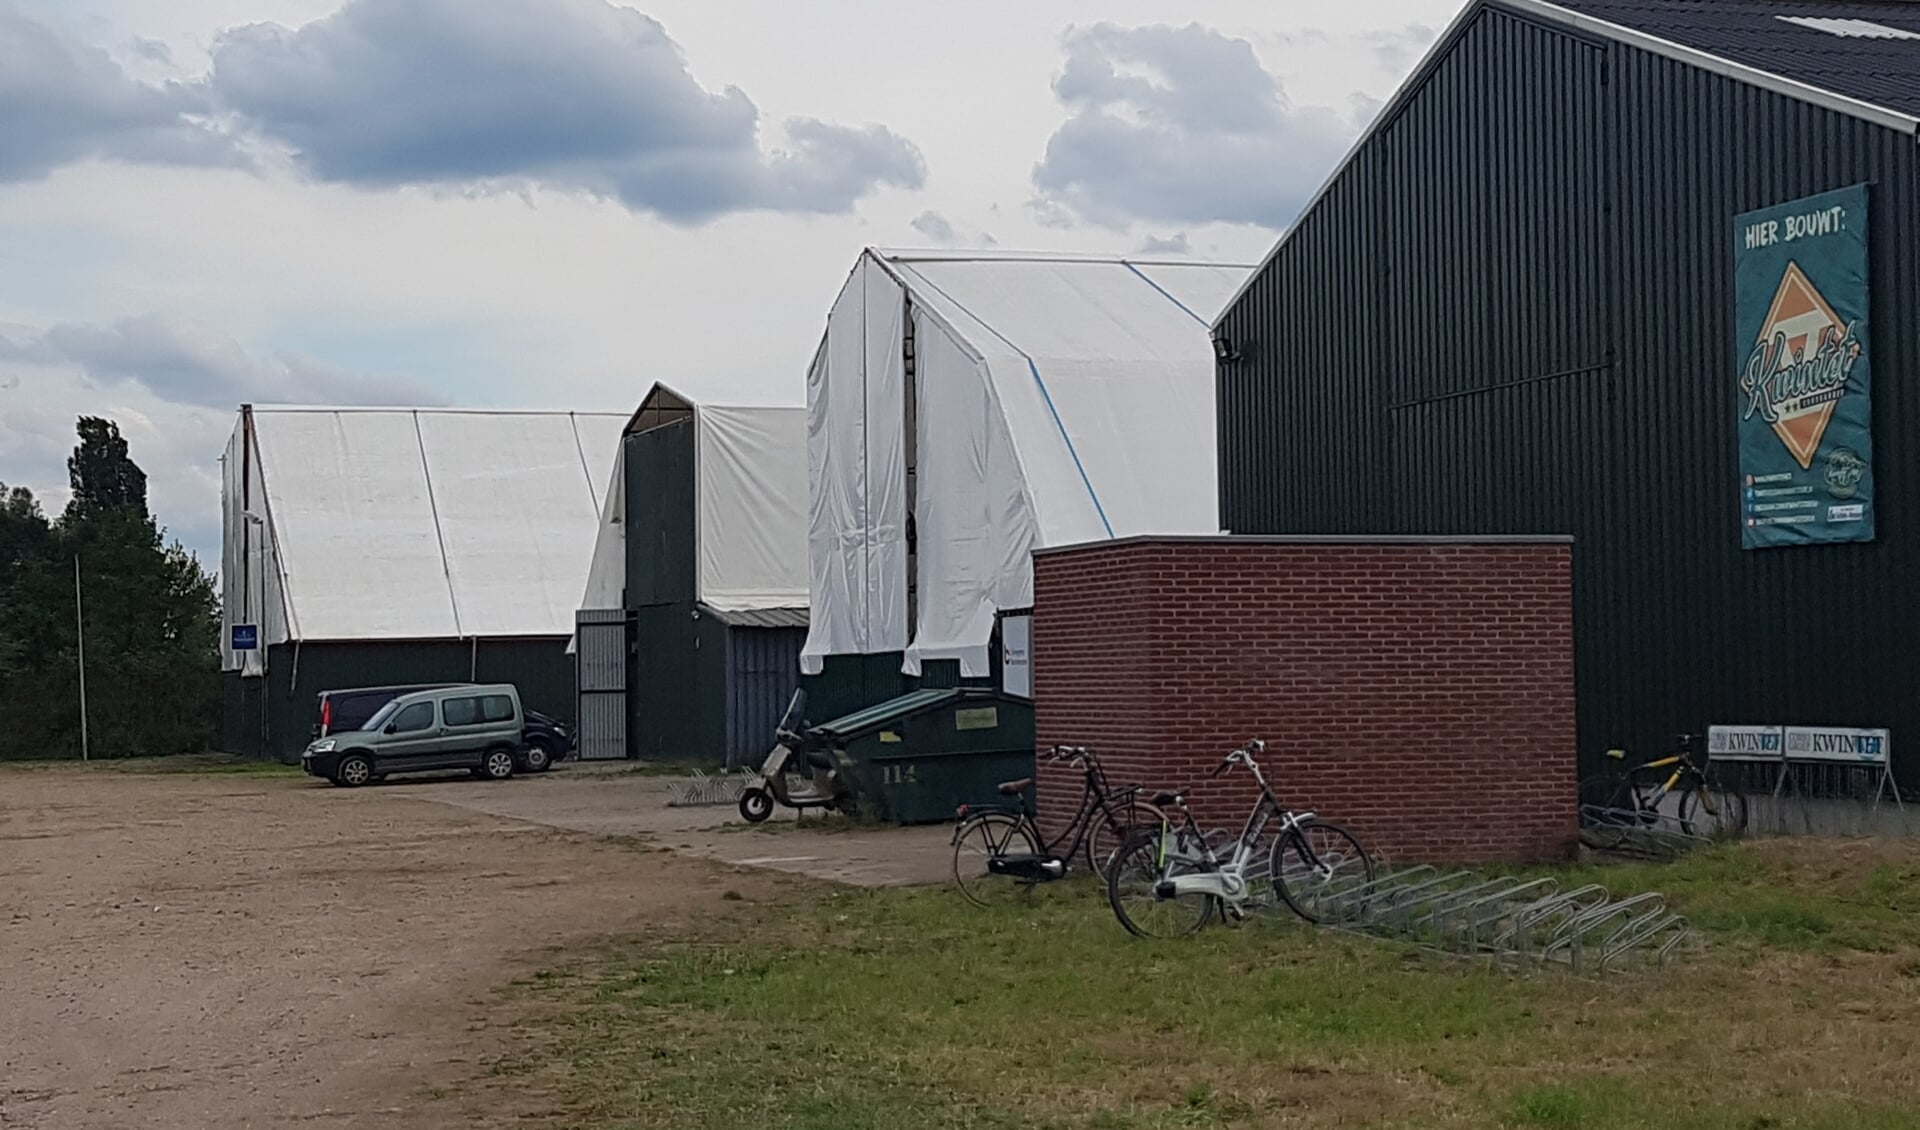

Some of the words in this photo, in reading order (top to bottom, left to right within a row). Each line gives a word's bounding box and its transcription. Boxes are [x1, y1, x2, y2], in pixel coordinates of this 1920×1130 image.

[1745, 220, 1779, 249] HIER
[1784, 206, 1846, 242] BOUWT:
[1728, 732, 1781, 751] KWINTET
[1812, 733, 1884, 754] KWINTET
[882, 764, 917, 785] 114
